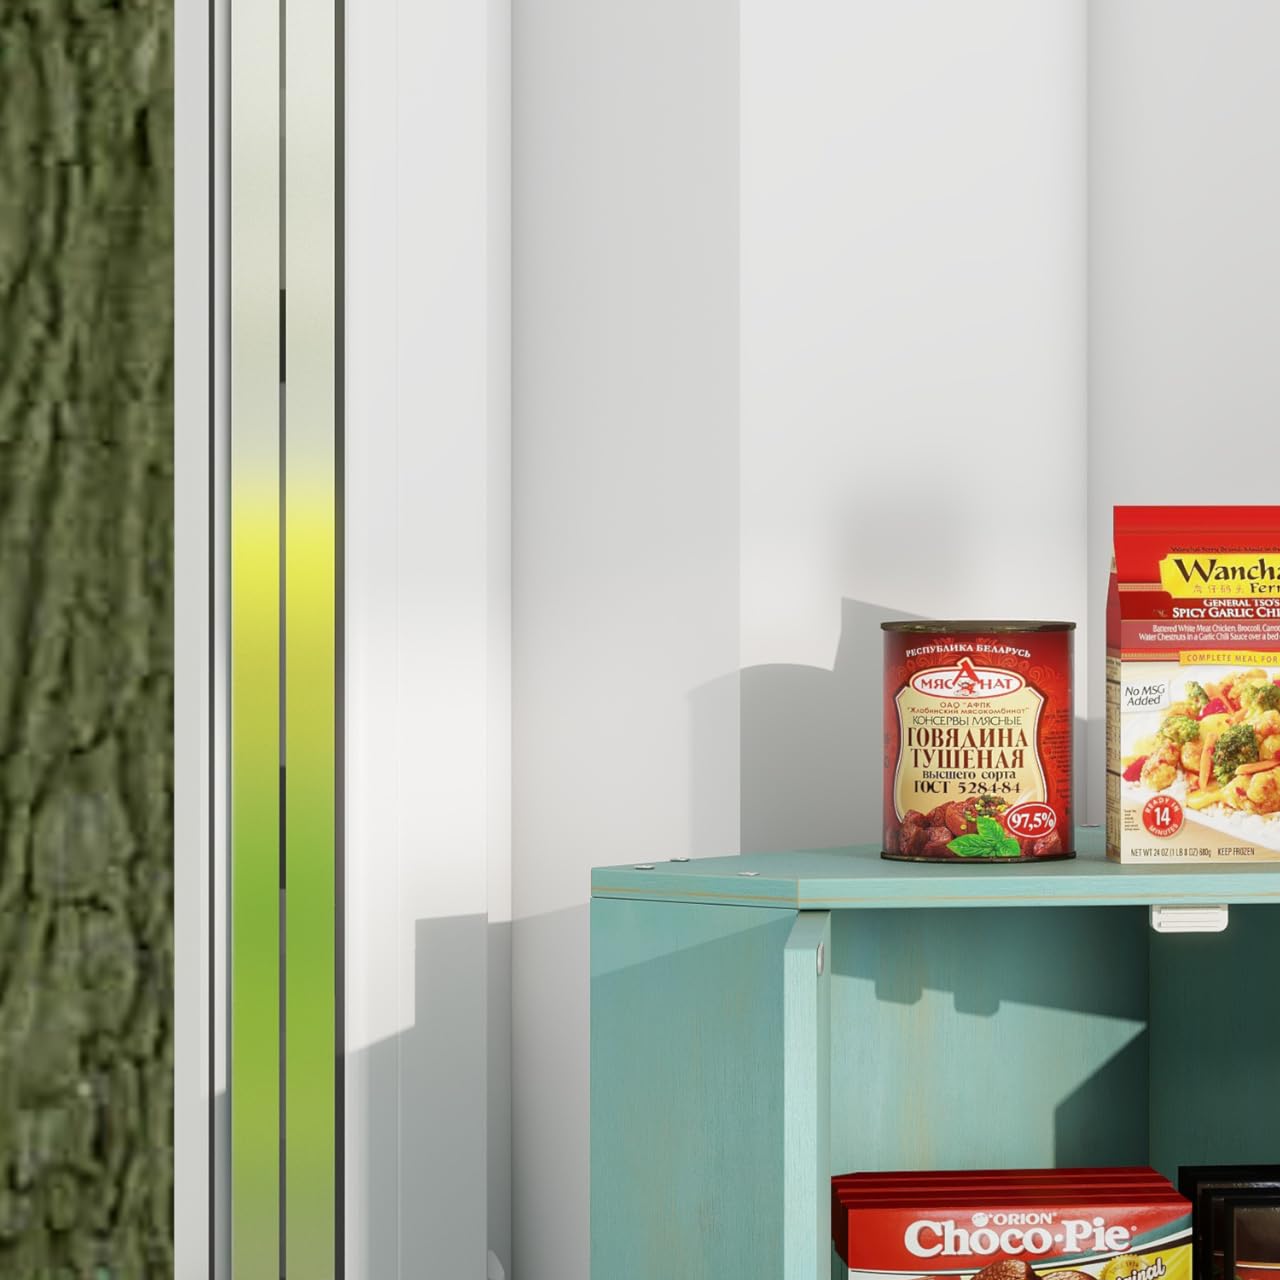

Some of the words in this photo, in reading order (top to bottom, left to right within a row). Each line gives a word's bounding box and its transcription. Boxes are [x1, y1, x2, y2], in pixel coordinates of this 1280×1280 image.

[1204, 599, 1250, 607] GENERAL
[1172, 607, 1206, 618] SPICY
[1208, 607, 1253, 618] GARLIC
[906, 644, 973, 658] РЕСПУБЛИКА
[976, 644, 1031, 658] БЕЛАРУСЬ
[1187, 654, 1232, 663] COMPLETE
[1235, 654, 1258, 663] MEAL
[1261, 655, 1278, 663] FOR
[1124, 686, 1140, 697] No
[1141, 684, 1165, 696] MSG
[1127, 694, 1161, 706] Added
[912, 716, 969, 726] КОНСЕРВЫ
[971, 716, 1023, 726] МЯСНЫЕ
[908, 727, 1029, 749] ГОВЯДИНА
[910, 748, 1024, 769] ТУШЕНАЯ
[922, 770, 976, 782] высшего
[981, 772, 1017, 783] сорта
[914, 781, 951, 794] ГОСТ
[958, 781, 1021, 794] 5284-84
[1011, 812, 1055, 831] 97,5%
[1154, 806, 1171, 826] 14
[1130, 848, 1143, 857] NET
[1143, 848, 1153, 857] WT
[1218, 848, 1233, 856] KEEP
[1233, 847, 1255, 856] FROZEN
[993, 1213, 1053, 1226] ORION
